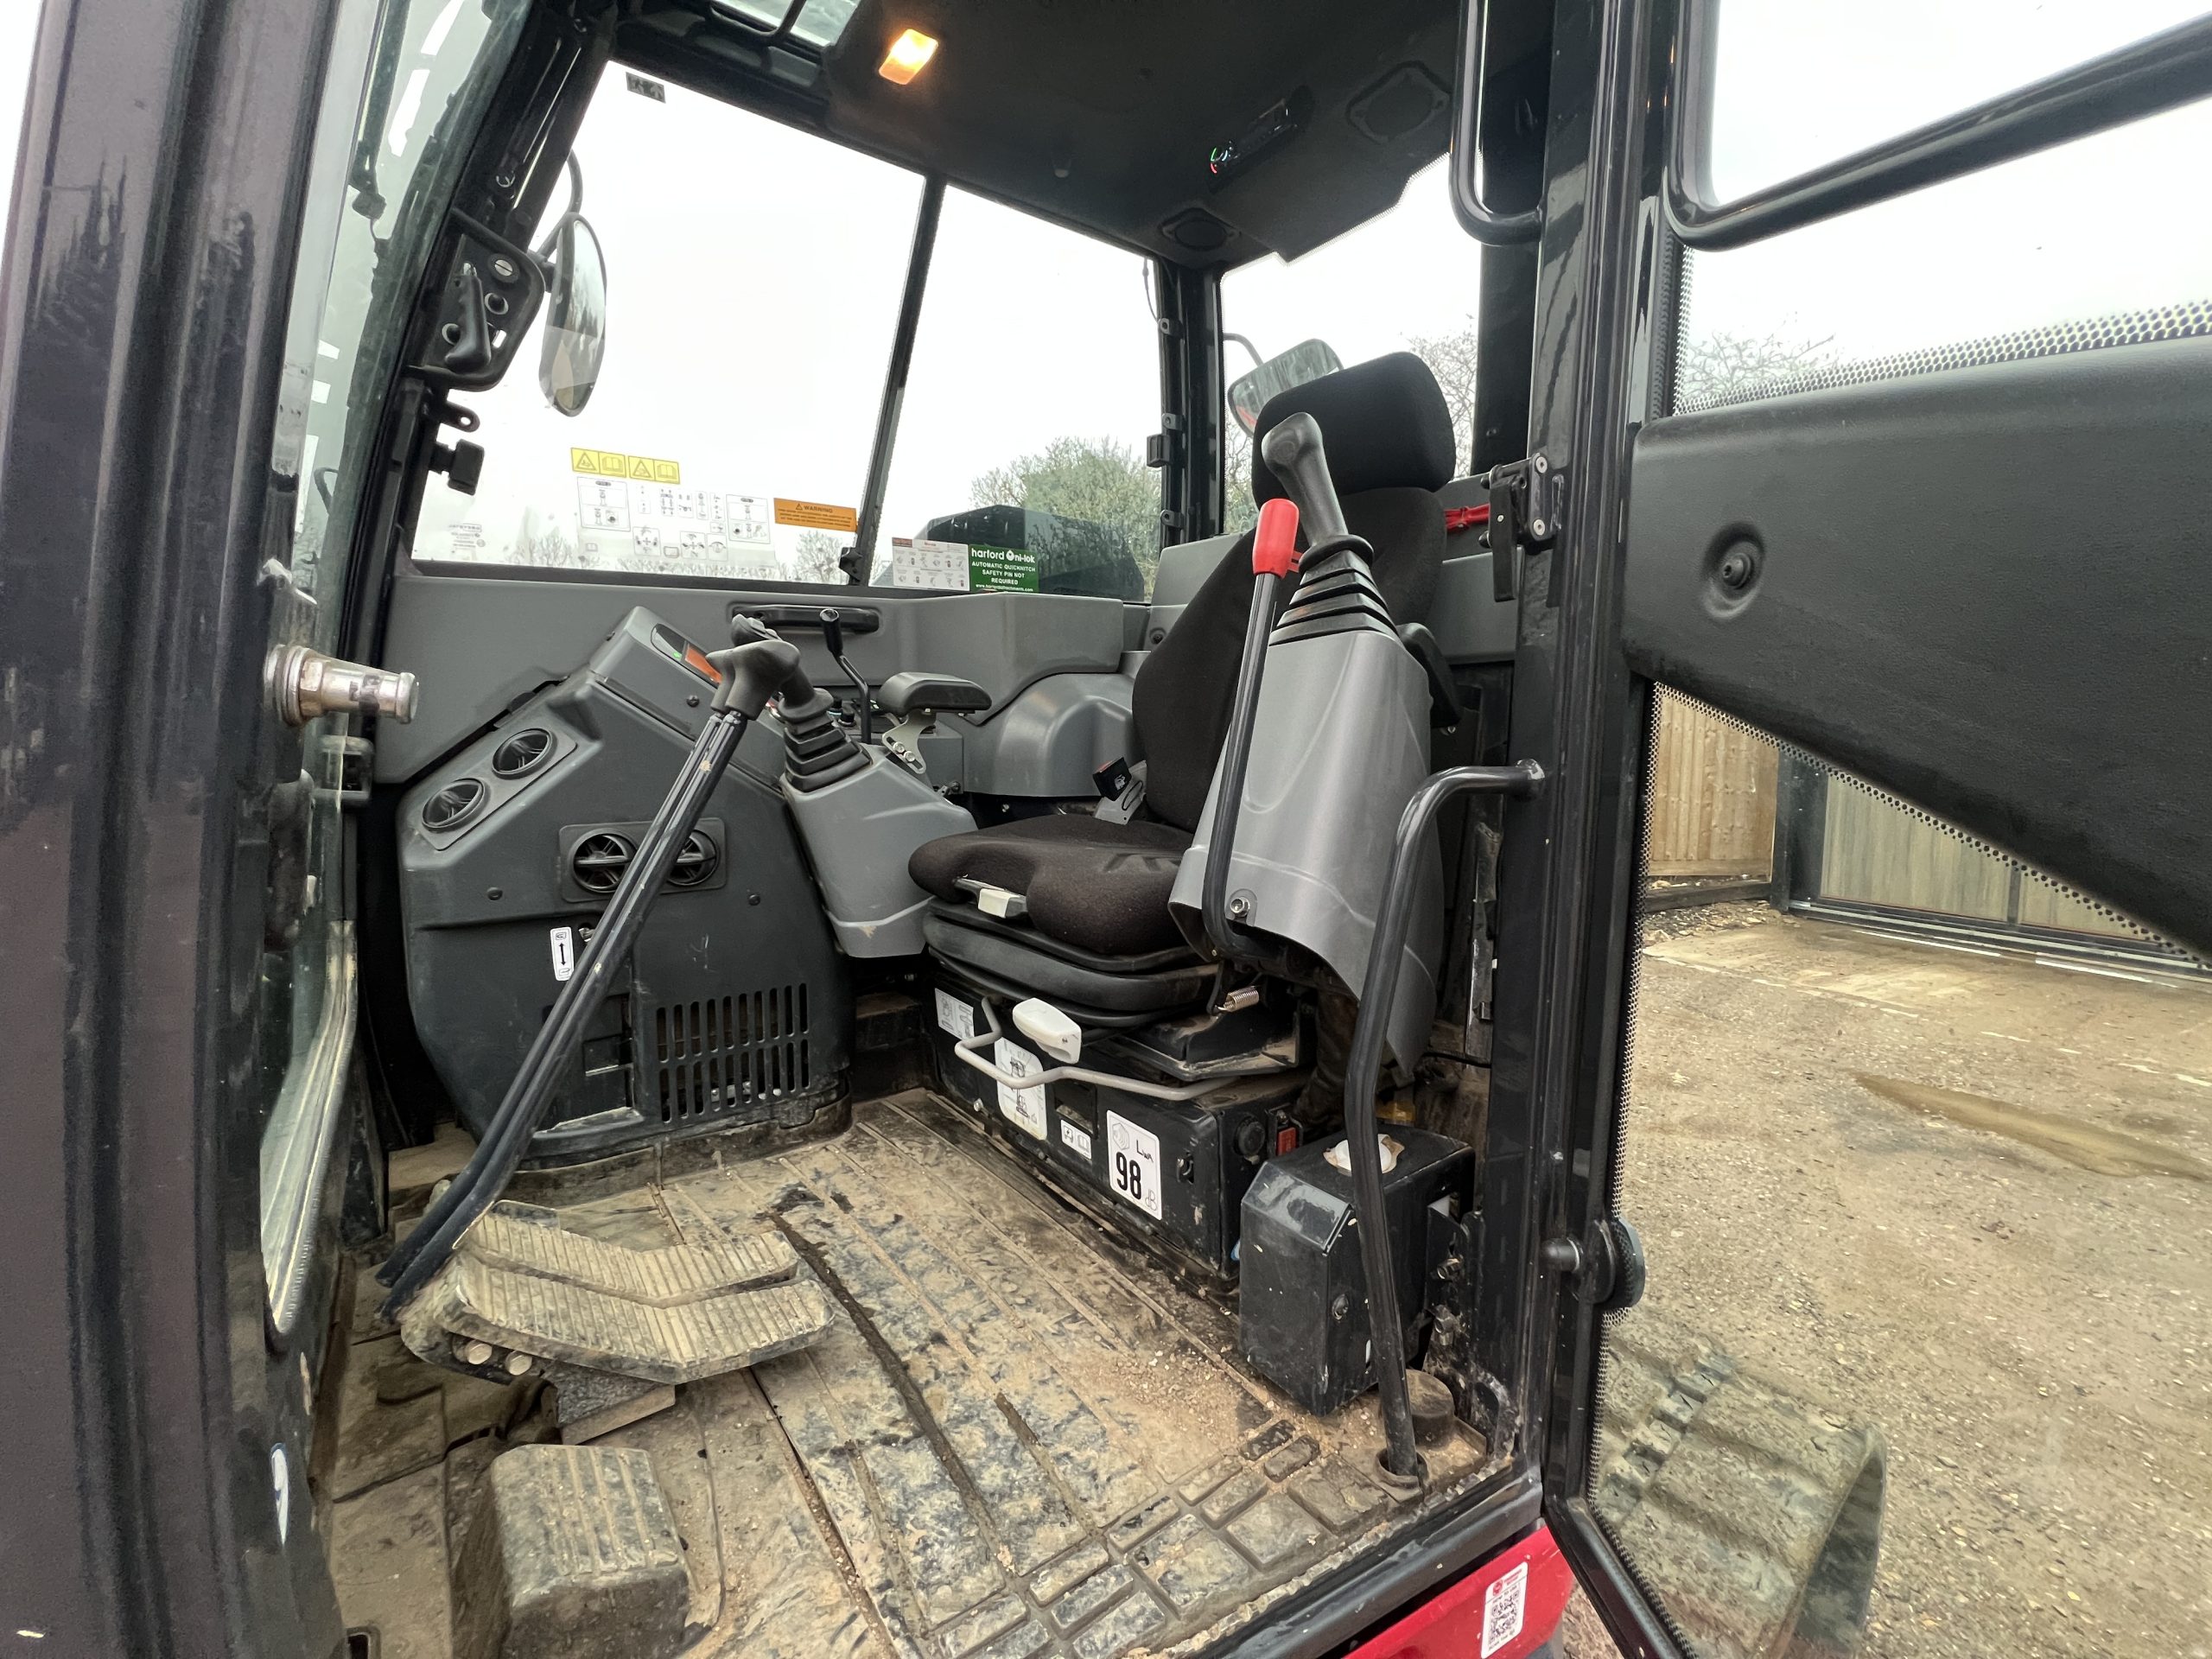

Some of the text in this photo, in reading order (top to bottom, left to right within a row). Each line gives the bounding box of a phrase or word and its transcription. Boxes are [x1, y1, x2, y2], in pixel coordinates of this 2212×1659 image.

[971, 548, 1005, 560] harford
[1116, 1151, 1141, 1200] 98
[1145, 1188, 1158, 1211] dB
